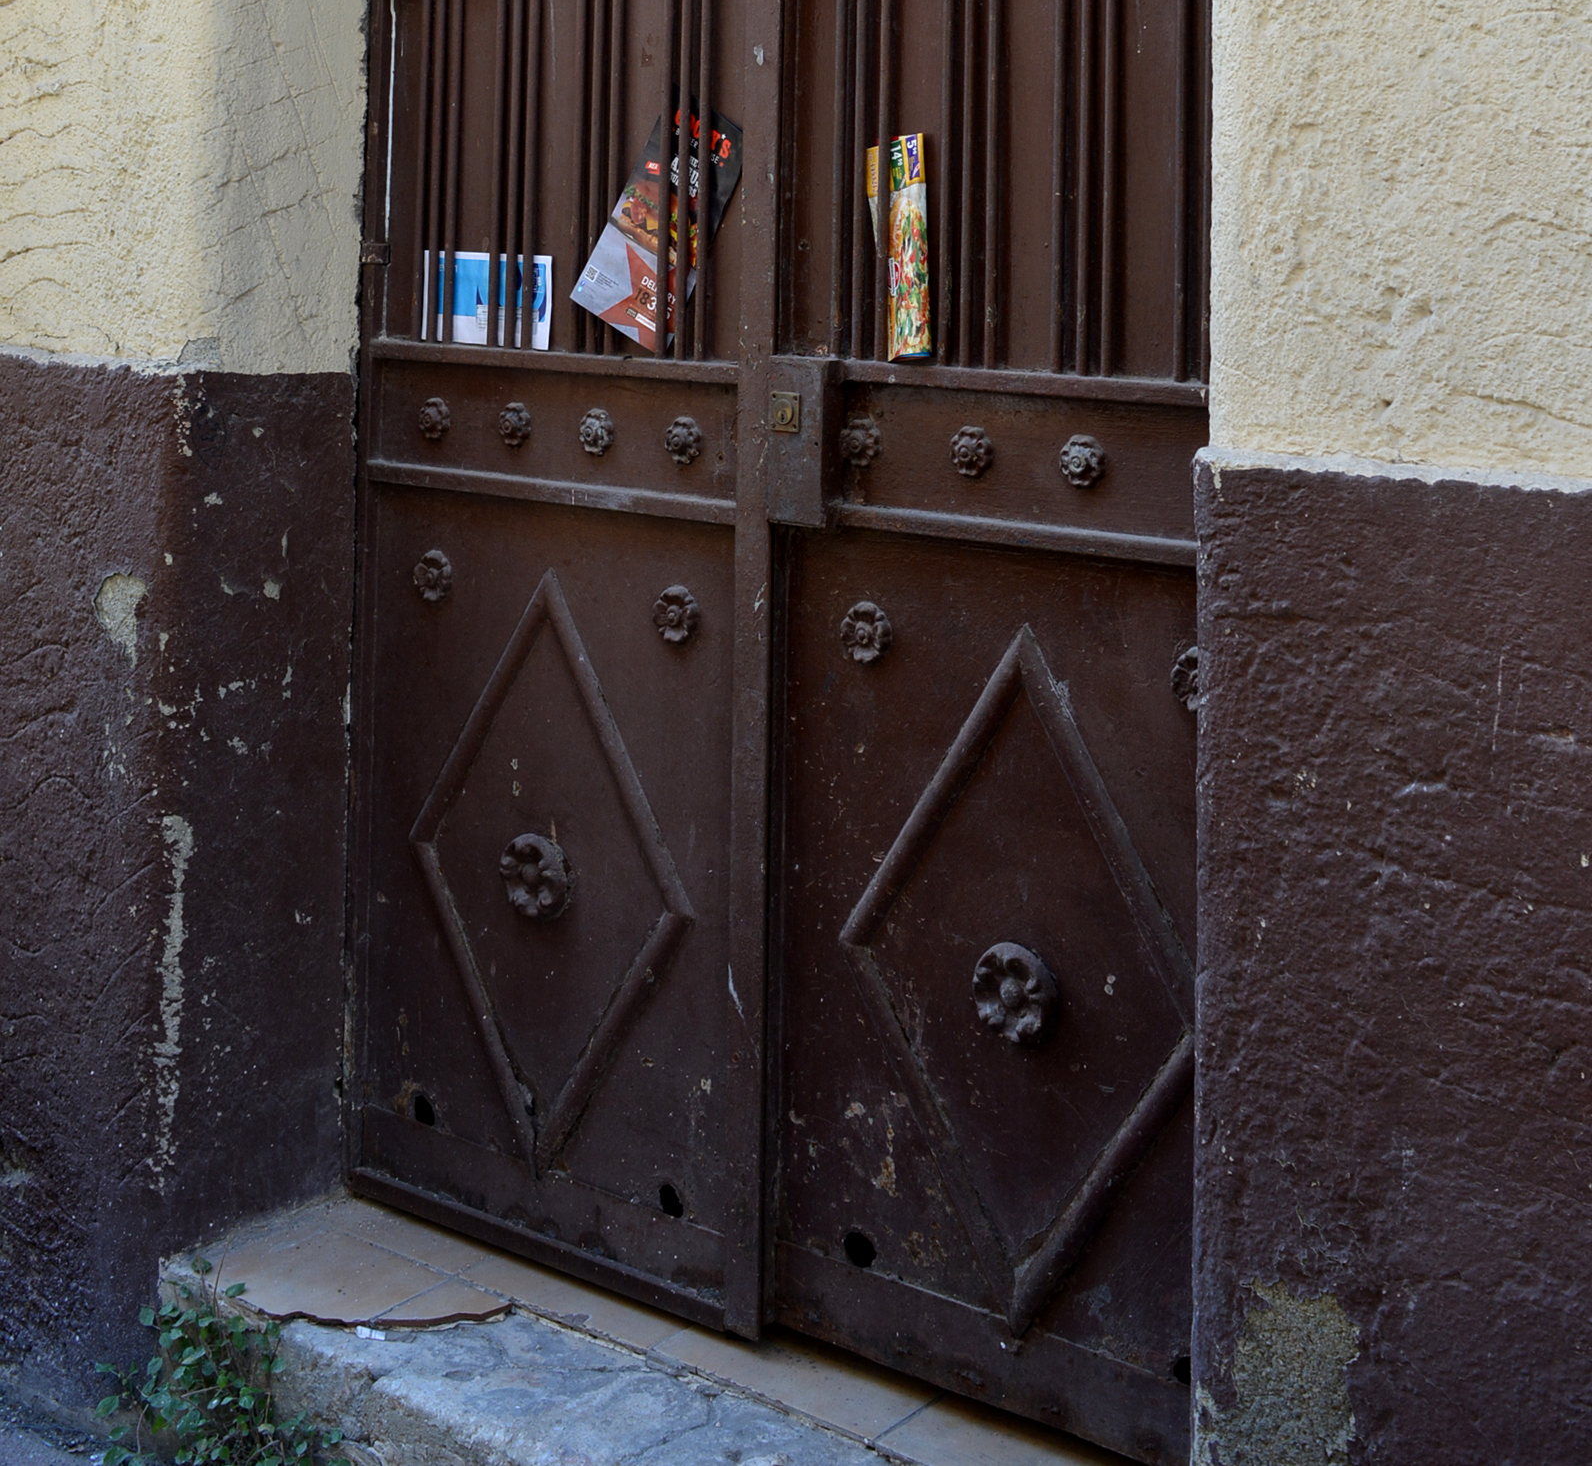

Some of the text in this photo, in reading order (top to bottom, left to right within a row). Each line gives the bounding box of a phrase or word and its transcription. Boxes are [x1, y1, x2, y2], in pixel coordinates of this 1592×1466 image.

[674, 109, 731, 159] GOY'S
[634, 288, 673, 320] 1835
[641, 276, 677, 305] DELRY
